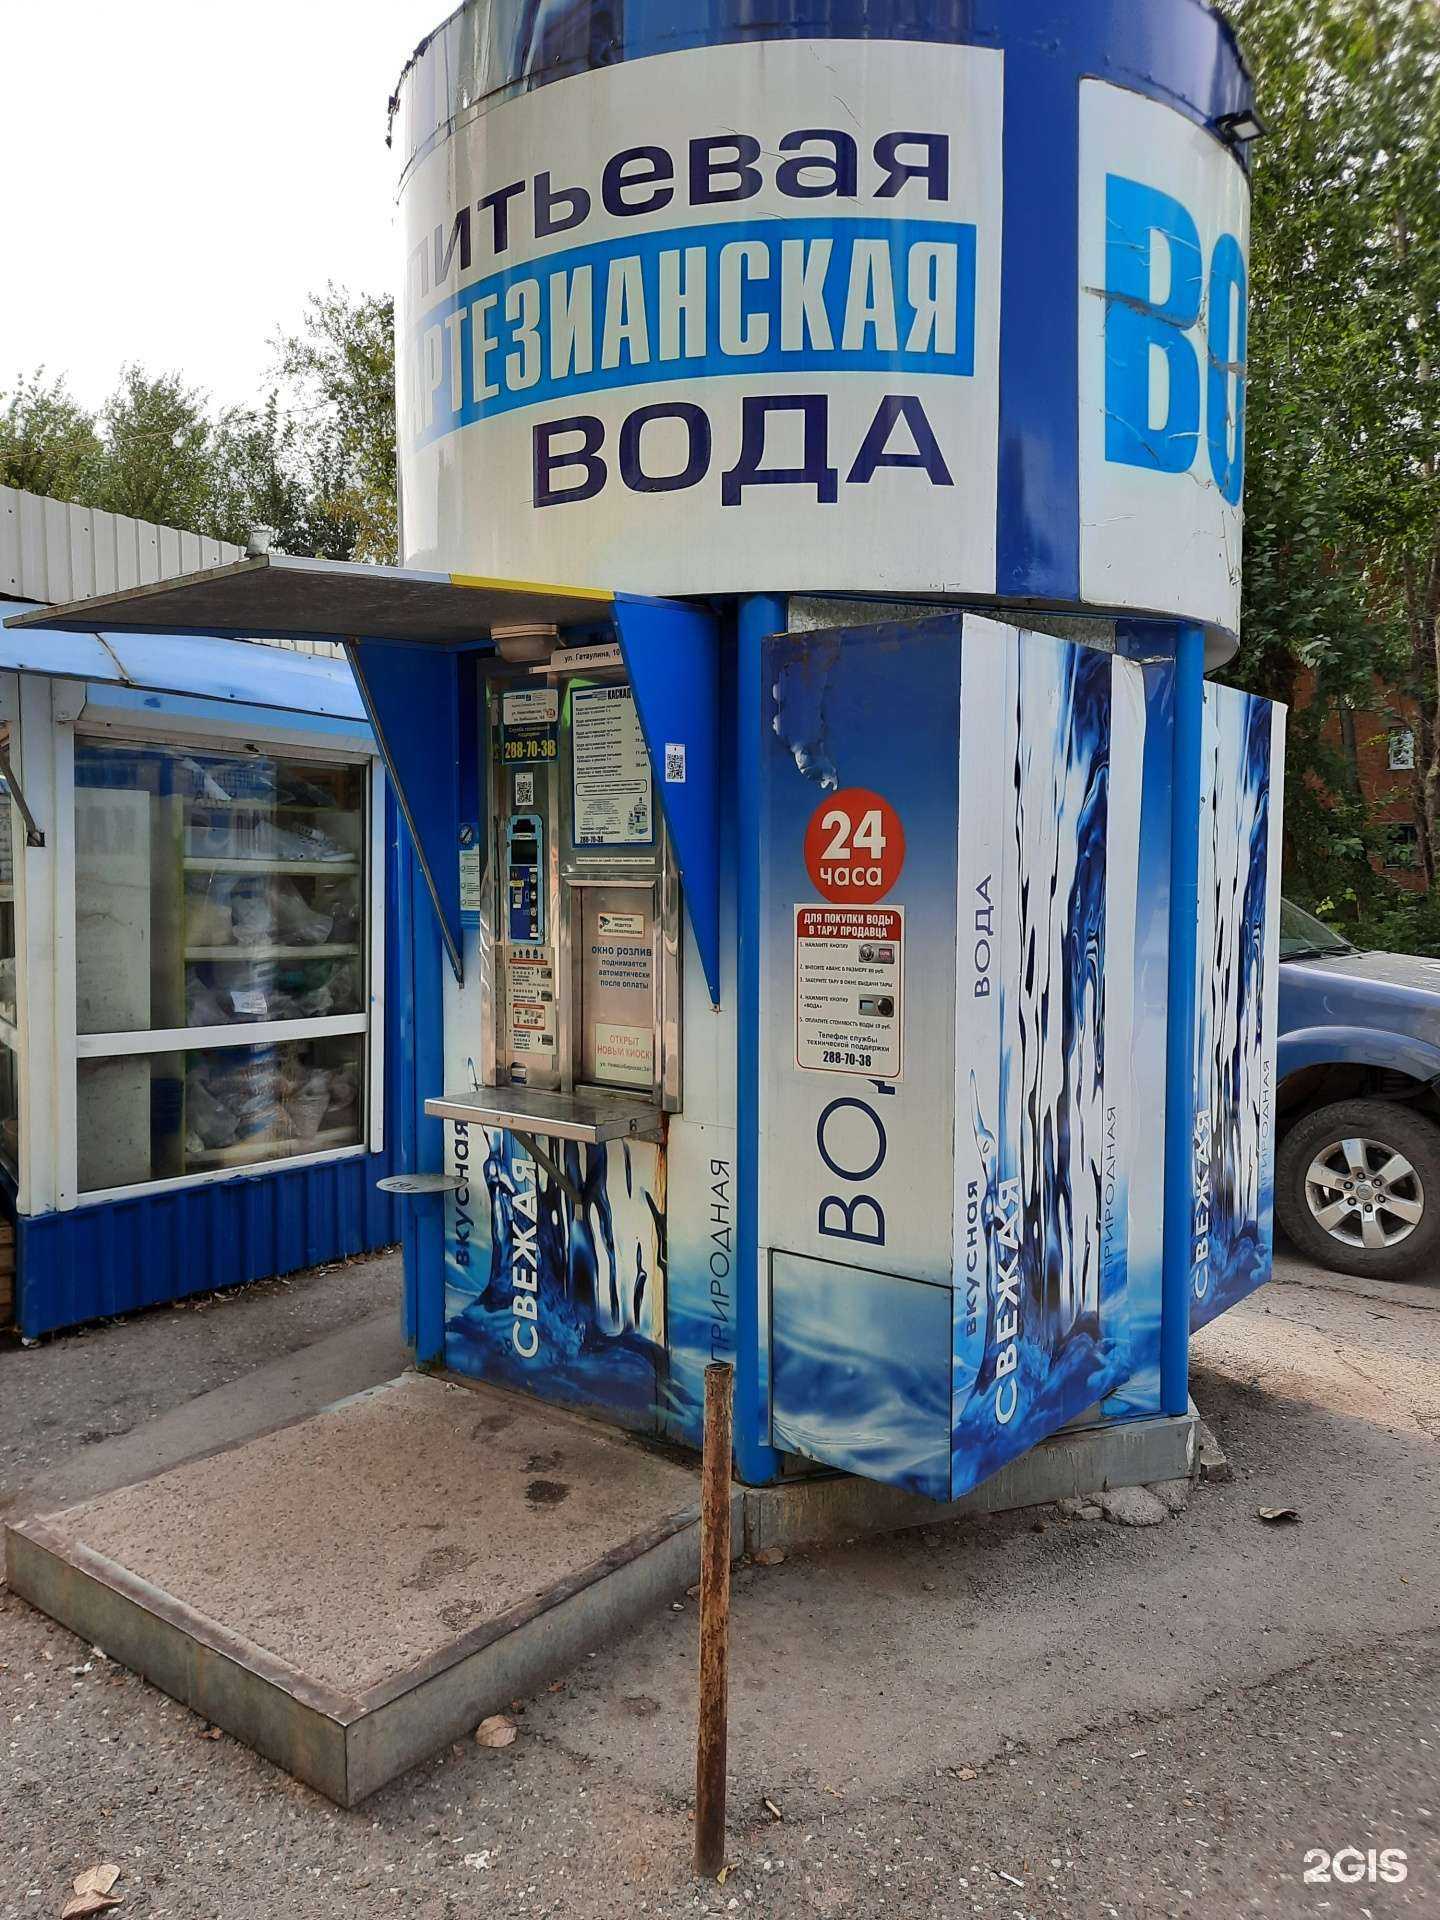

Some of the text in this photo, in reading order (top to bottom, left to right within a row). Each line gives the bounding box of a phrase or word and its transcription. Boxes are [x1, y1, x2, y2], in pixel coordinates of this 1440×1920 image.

[407, 128, 950, 298] питьевая
[532, 393, 955, 508] ВОДА
[505, 739, 556, 759] 288-70-38
[819, 865, 884, 888] часа
[820, 809, 887, 861] 24
[804, 913, 894, 926] ДЛЯ ПОКУПКИ ВОДЫ
[809, 926, 888, 938] В ТАРУ ПРОДАВЦА
[974, 873, 993, 998] ВОДА
[806, 1039, 890, 1052] технической поддержки
[817, 1030, 878, 1044] Телефон службы
[823, 1050, 872, 1067] 288-70-38
[1104, 1104, 1117, 1280] ПРИРОДНАЯ
[1193, 1108, 1211, 1299] СВЕЖАЯ
[512, 1158, 538, 1358] СВЕЖАЯ
[709, 1158, 730, 1365] ПРИРОДНАЯ
[994, 1176, 1022, 1425] СВЕЖАЯ
